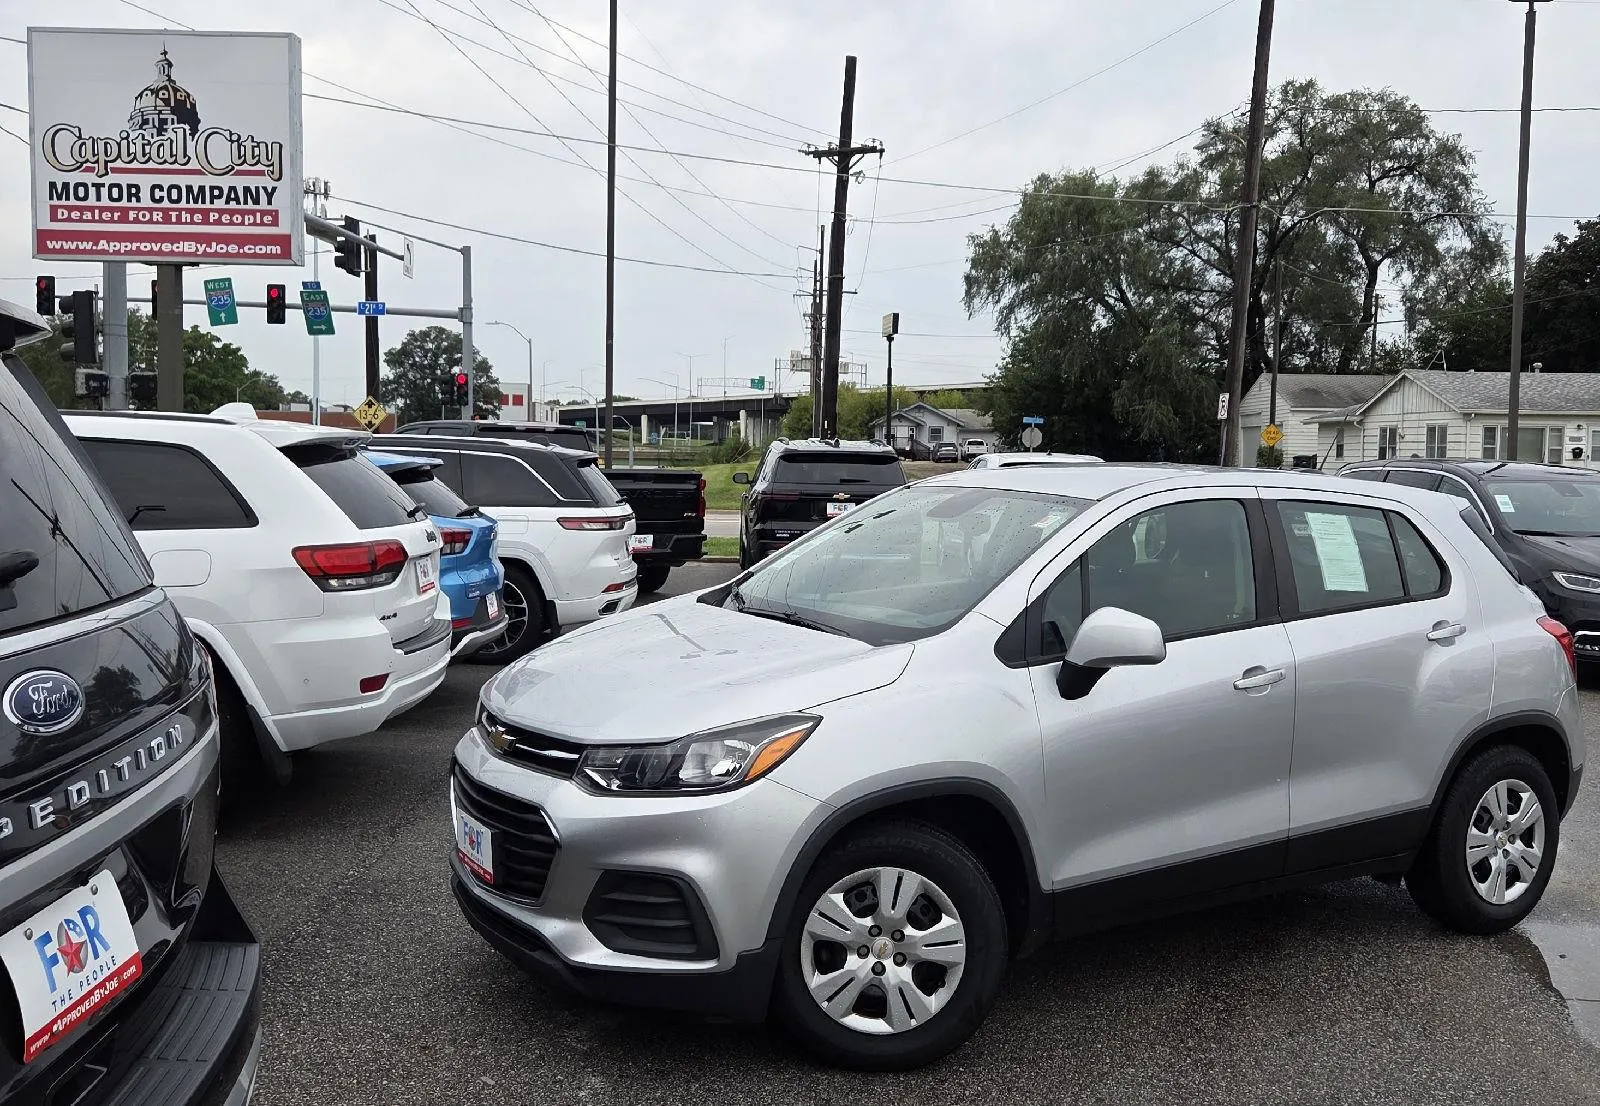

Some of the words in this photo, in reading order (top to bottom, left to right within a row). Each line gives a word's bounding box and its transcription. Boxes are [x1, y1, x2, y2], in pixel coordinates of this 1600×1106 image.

[42, 122, 191, 178] Capital
[195, 126, 283, 182] City
[48, 181, 142, 204] MOTOR
[149, 183, 278, 206] COMPANY
[57, 208, 121, 221] Dealer
[128, 210, 163, 222] FOR
[169, 211, 203, 223] The
[46, 239, 281, 255] www.ApprovedByJoe.com
[206, 281, 230, 290] WEST
[211, 294, 231, 305] 235
[303, 293, 325, 301] EAST
[307, 307, 327, 317] 235
[379, 612, 398, 621] 4x4
[28, 680, 73, 719] Ford
[33, 904, 112, 995] FOR
[51, 988, 73, 1013] THE
[79, 955, 118, 992] PEOPLE
